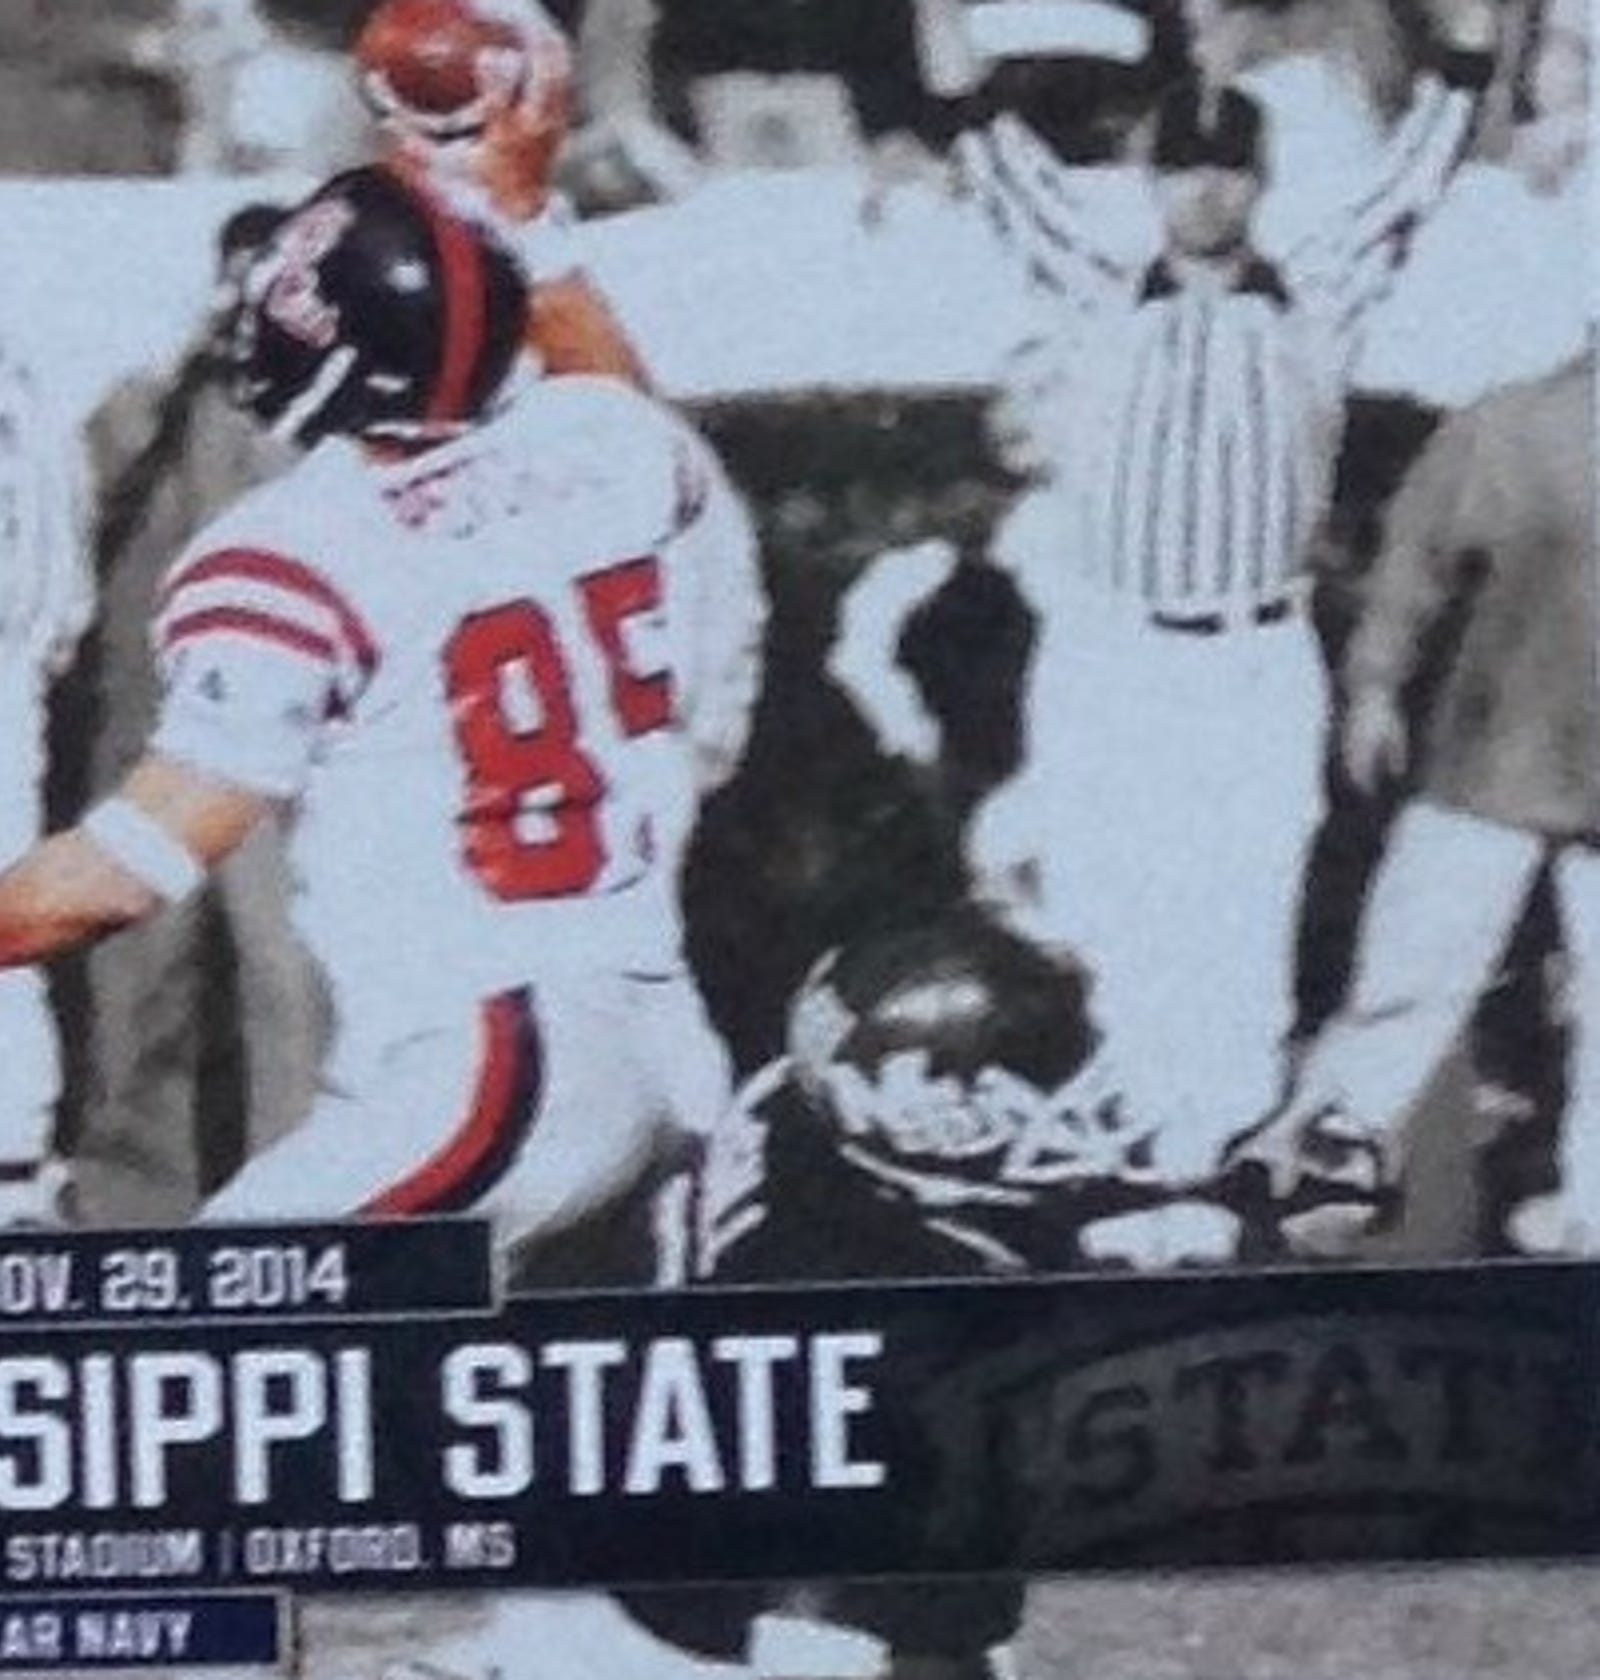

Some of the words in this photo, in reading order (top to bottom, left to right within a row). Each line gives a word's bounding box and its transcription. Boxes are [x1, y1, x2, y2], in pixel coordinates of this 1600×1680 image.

[208, 1243, 349, 1307] 2014
[440, 1333, 886, 1499] STATE
[5, 1526, 201, 1581] STADIUM
[444, 1520, 516, 1570] MS
[75, 1610, 194, 1657] NAVY
